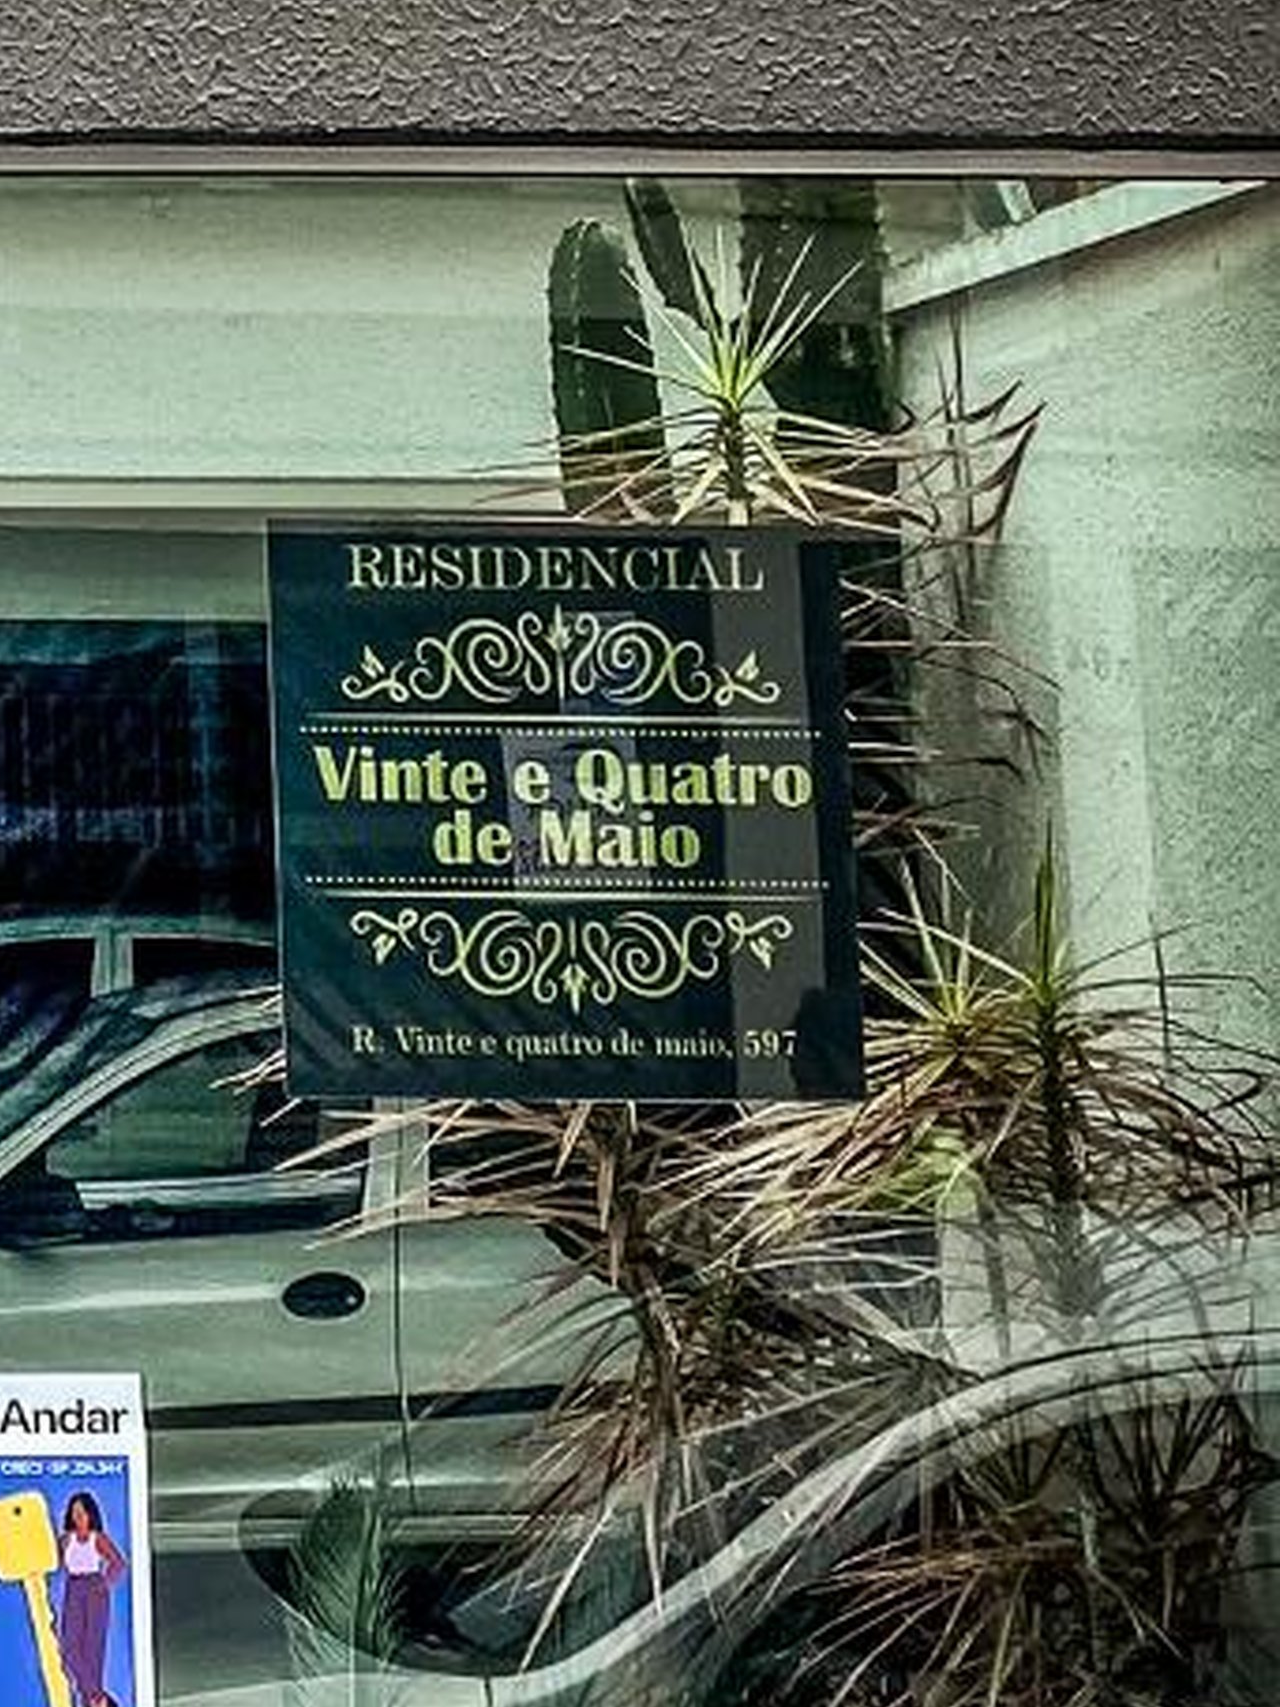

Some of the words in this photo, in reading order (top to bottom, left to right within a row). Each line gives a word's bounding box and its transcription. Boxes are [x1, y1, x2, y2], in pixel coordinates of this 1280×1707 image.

[346, 543, 765, 593] RESIDENCIAL
[313, 744, 487, 804] Vinte
[514, 761, 551, 801] e
[573, 747, 813, 813] Quatro
[433, 812, 512, 867] de
[540, 811, 701, 868] Maio
[351, 1026, 384, 1054] R.
[394, 1026, 473, 1055] Vinte
[480, 1034, 498, 1055] e
[505, 1030, 603, 1063] quatro
[611, 1027, 645, 1056] de
[743, 1028, 798, 1059] 597
